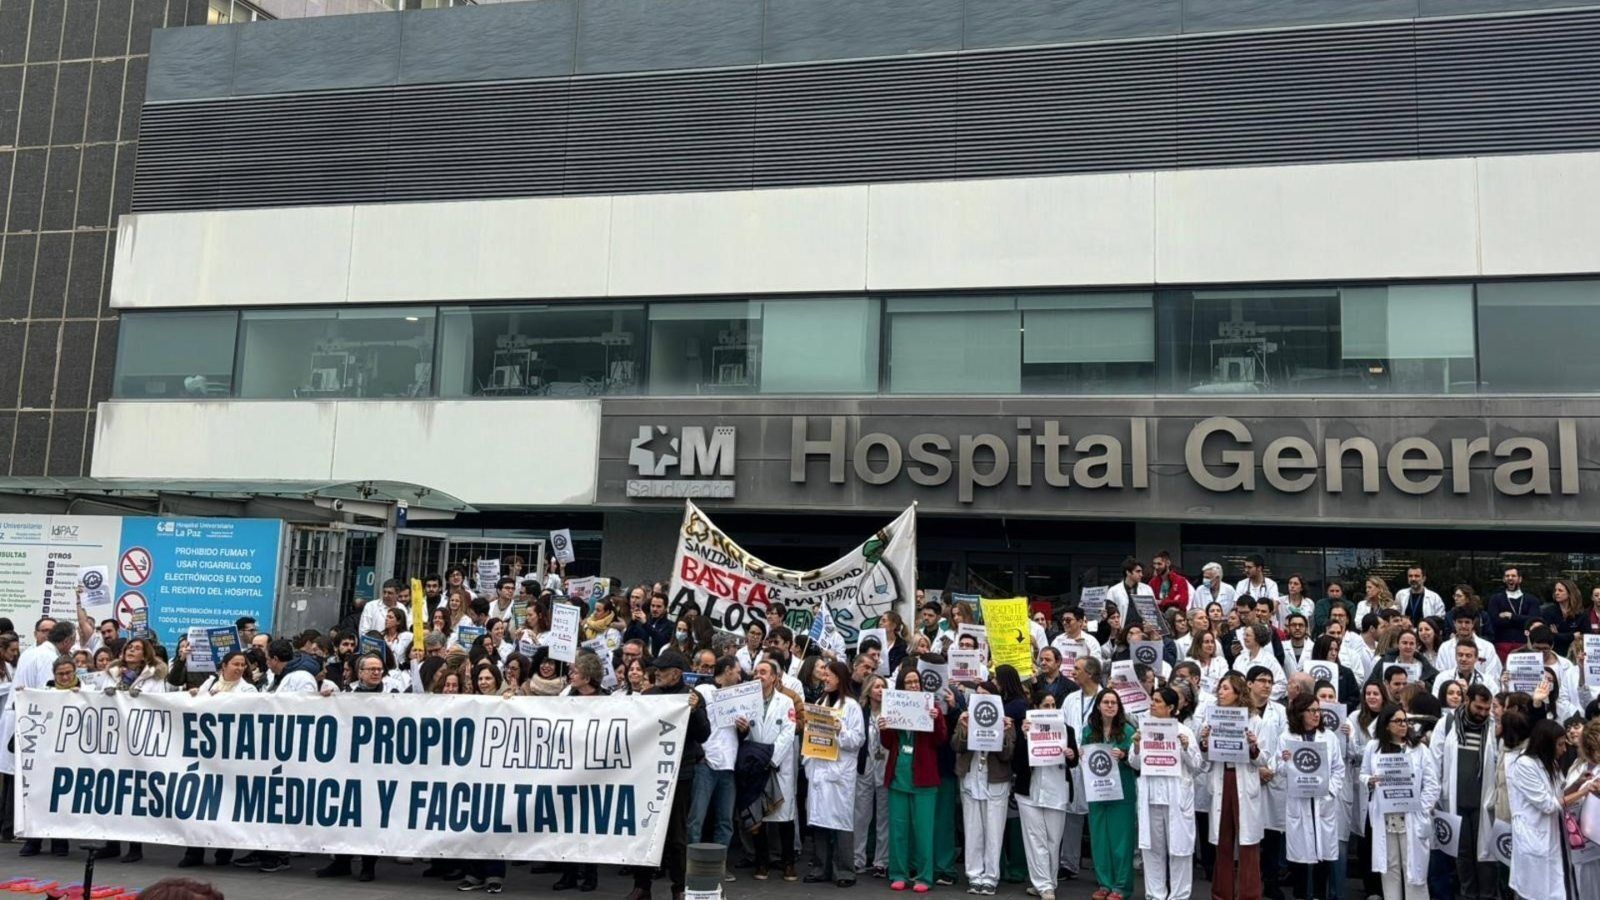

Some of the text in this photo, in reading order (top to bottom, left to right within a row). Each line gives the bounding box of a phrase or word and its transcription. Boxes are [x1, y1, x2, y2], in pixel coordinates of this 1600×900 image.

[790, 415, 1579, 503] Hospital General
[627, 480, 733, 497] SaludMadrid
[175, 529, 202, 537] La Paz
[175, 547, 256, 557] PROHIBIDO FUMAR Y
[685, 537, 738, 569] SANIDAD
[199, 561, 252, 570] CIGARRILLOS
[164, 572, 261, 583] ELECTRÓNICOS EN TODO
[681, 555, 771, 608] BASTA
[160, 585, 263, 597] EL RECINTO DEL HOSPITAL
[768, 587, 781, 599] DE
[669, 586, 768, 632] A LOS
[1040, 723, 1050, 732] STOP
[55, 705, 632, 769] POR UN ESTATUTO PROPIO PARA LA
[1153, 732, 1164, 741] STOP
[49, 761, 636, 837] PROFESIÓN MÉDICA Y FACULTATIVA
